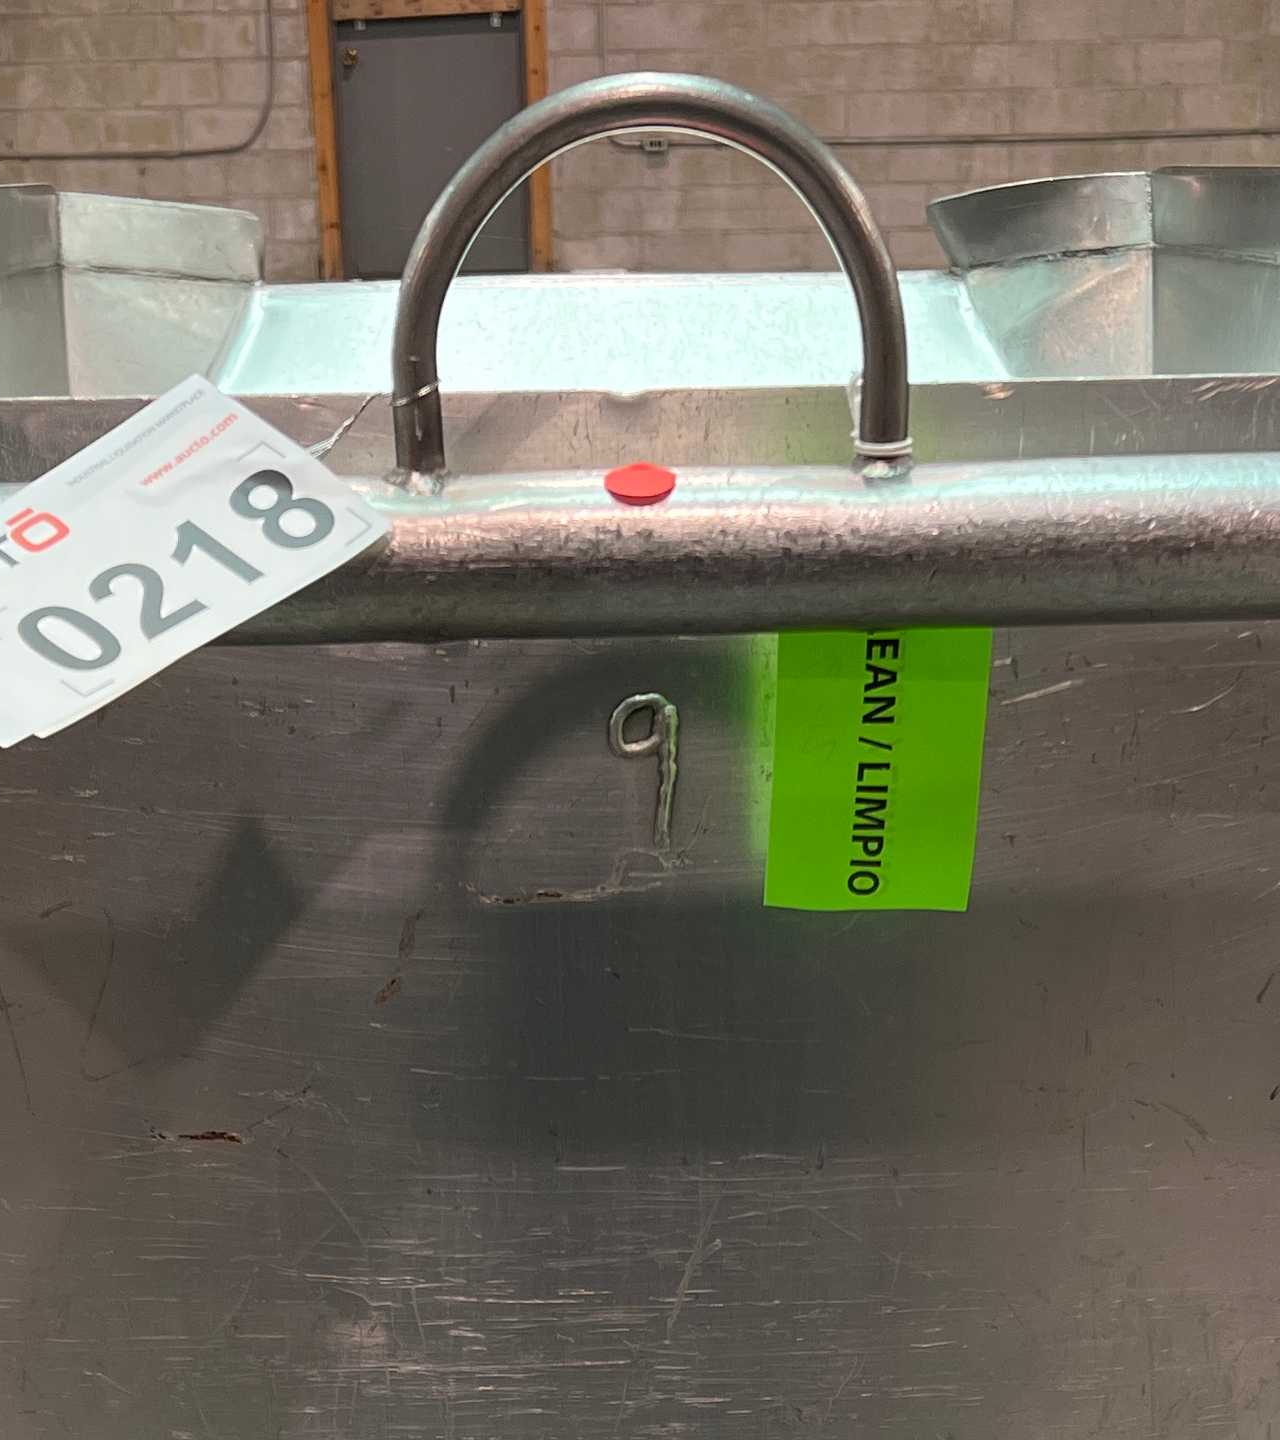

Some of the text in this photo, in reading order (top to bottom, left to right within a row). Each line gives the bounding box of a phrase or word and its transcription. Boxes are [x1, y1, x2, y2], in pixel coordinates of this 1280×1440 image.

[140, 412, 239, 486] www.aucto.com
[17, 469, 336, 672] 0218
[848, 632, 900, 896] EAN / LIMPIO
